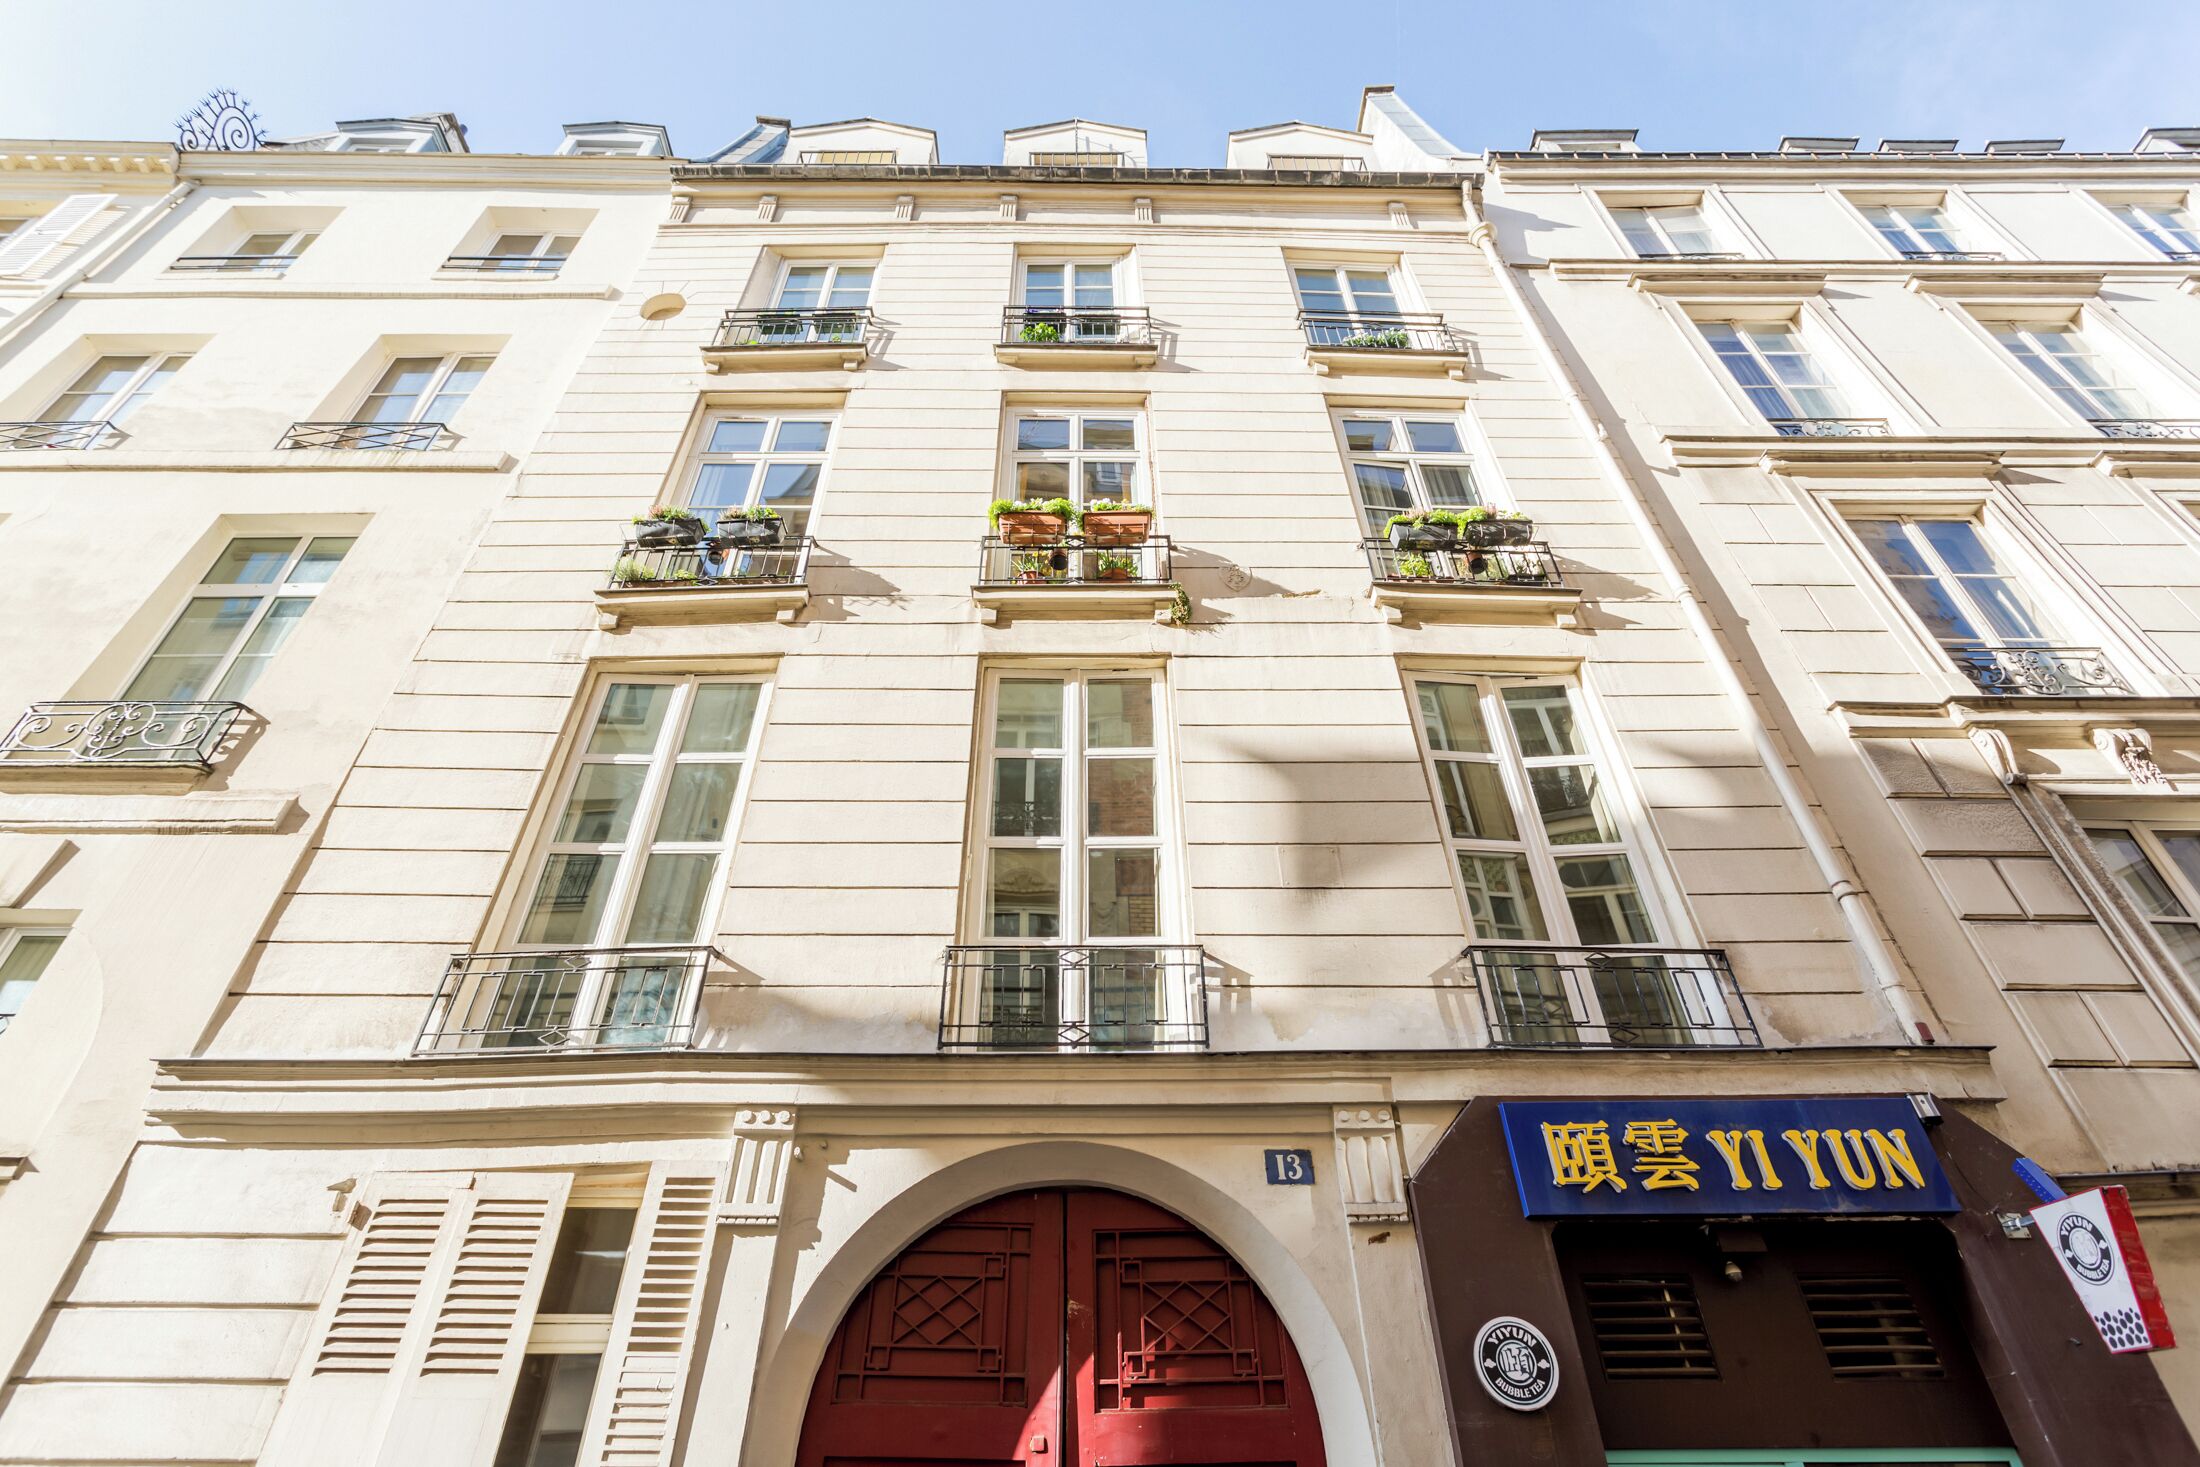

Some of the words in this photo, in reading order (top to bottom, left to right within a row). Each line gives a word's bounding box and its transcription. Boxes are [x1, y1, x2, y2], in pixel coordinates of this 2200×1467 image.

[1541, 1119, 1700, 1193] 頤雲
[1706, 1130, 1783, 1190] YI
[1782, 1129, 1926, 1190] YUN
[1275, 1154, 1303, 1180] 13
[2060, 1216, 2092, 1236] YIYUN
[1487, 1326, 1537, 1347] YIYUN
[1495, 1377, 1532, 1398] BUBBLE
[1529, 1379, 1546, 1395] TEA
